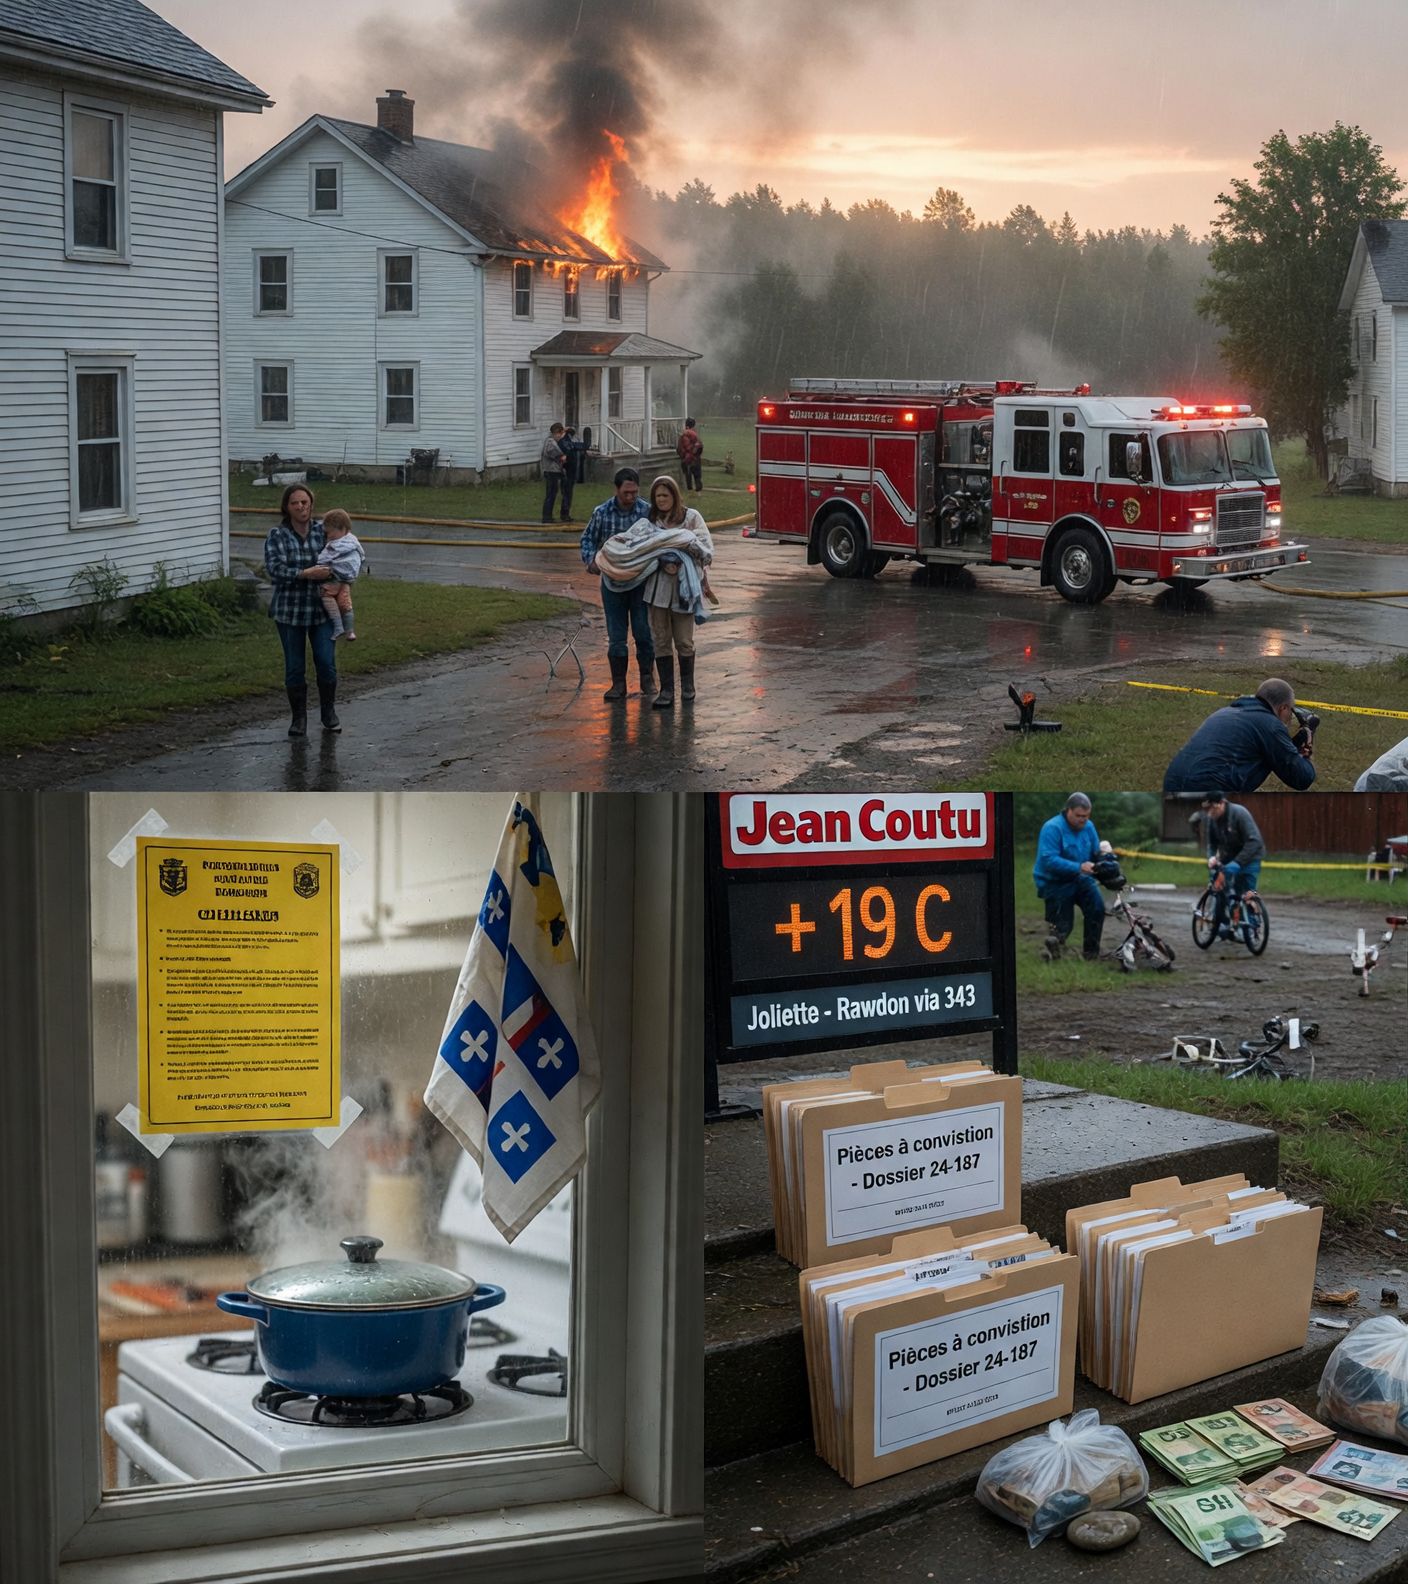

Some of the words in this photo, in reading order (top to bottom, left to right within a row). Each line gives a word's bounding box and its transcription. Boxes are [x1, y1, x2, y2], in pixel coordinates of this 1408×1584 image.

[736, 800, 852, 846] Jean
[858, 799, 981, 842] Coutu
[915, 884, 953, 953] C
[747, 1002, 819, 1031] Joliette
[837, 992, 909, 1021] Rawdon
[914, 988, 940, 1011] via
[944, 984, 976, 1009] 343
[837, 1144, 894, 1165] Pièces
[898, 1138, 908, 1155] à
[913, 1125, 993, 1152] convistion
[863, 1166, 926, 1190] Dossier
[930, 1153, 981, 1178] 24-187
[888, 1342, 948, 1370] Pièces
[952, 1333, 962, 1352] à
[967, 1312, 1050, 1347] convistion
[915, 1360, 980, 1392] Dossier
[984, 1340, 1038, 1372] 24-187
